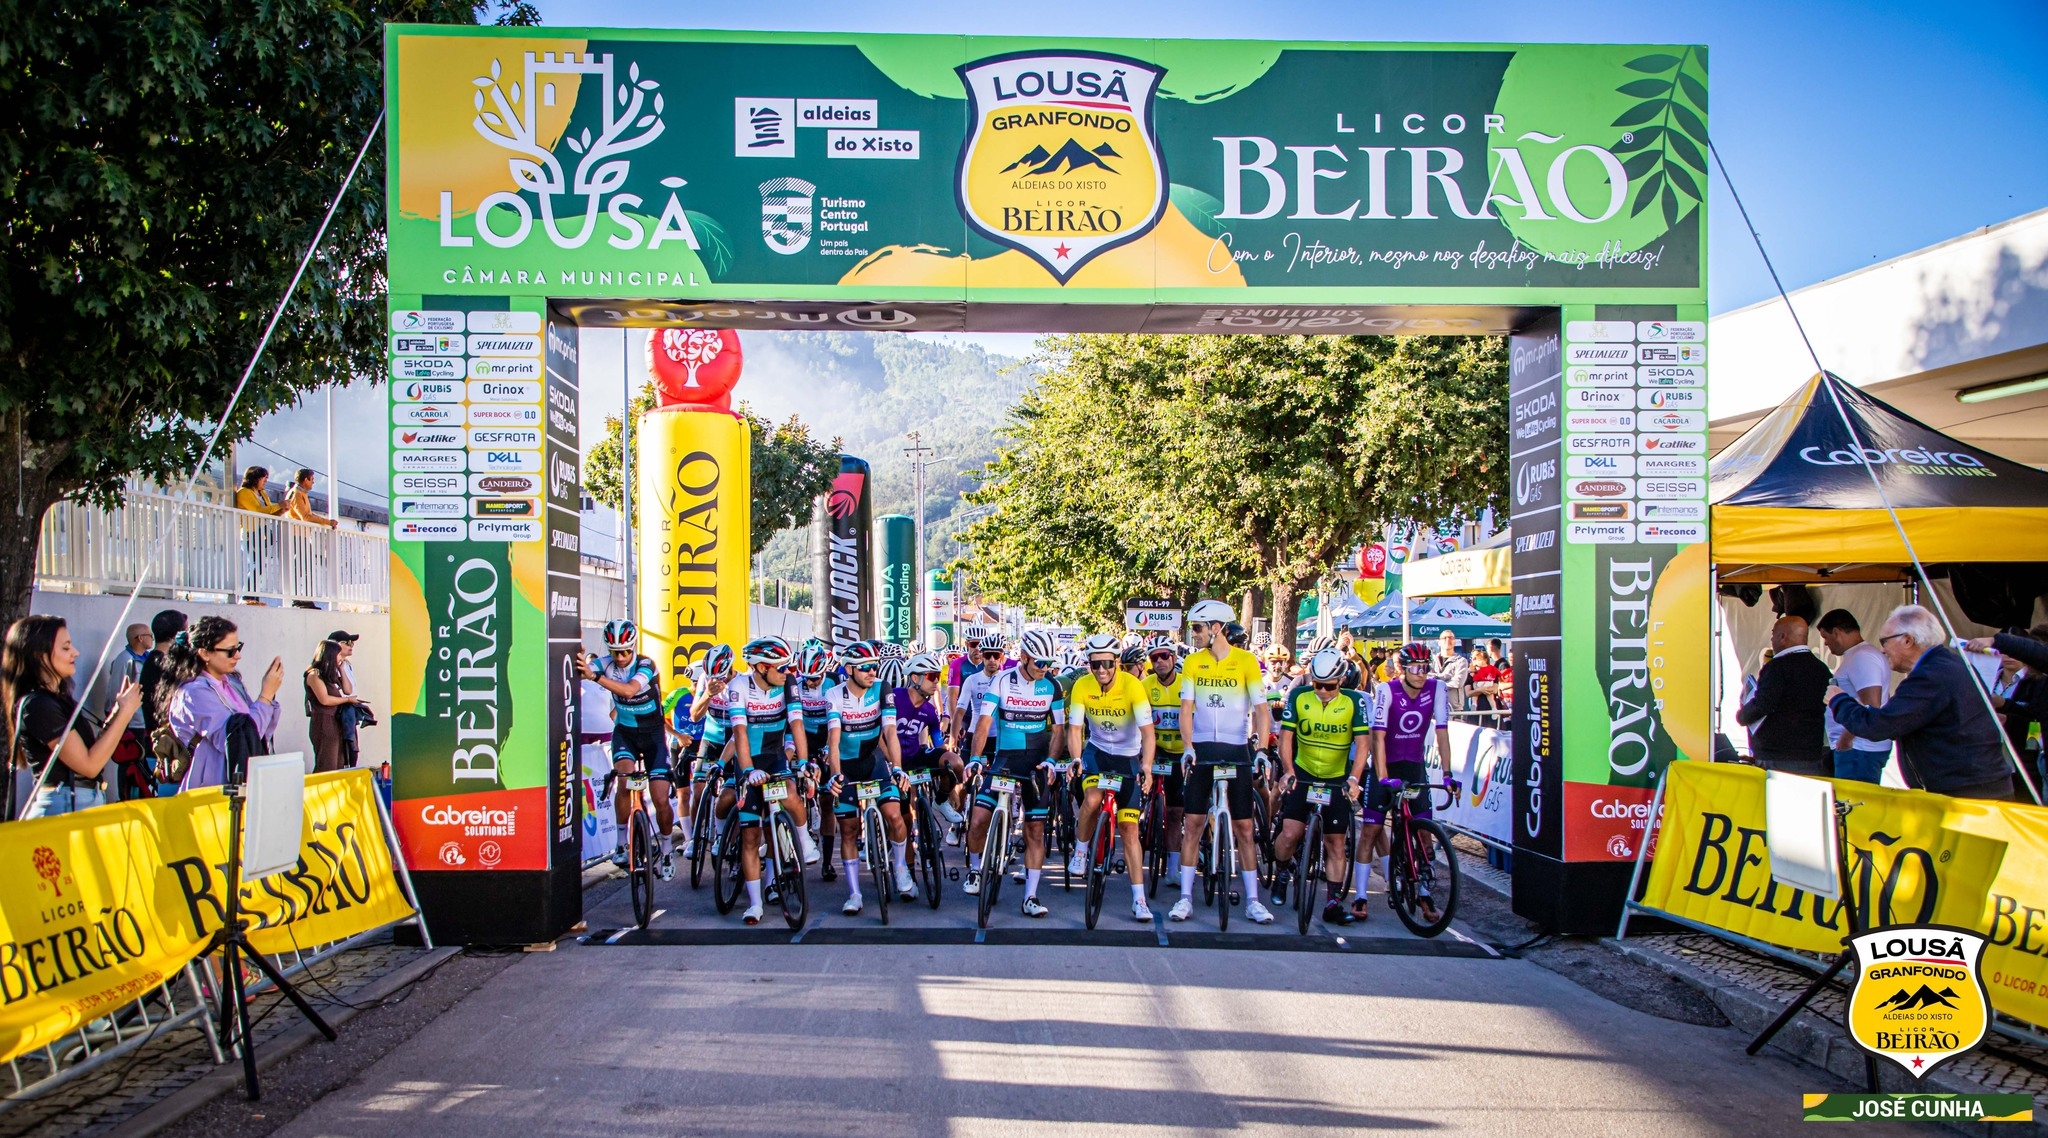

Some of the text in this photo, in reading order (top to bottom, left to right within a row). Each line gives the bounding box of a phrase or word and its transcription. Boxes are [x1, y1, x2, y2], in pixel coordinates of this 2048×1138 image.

[993, 69, 1130, 103] LOUSÃ
[803, 104, 872, 123] aldeias
[992, 111, 1132, 133] GRANFONDO
[1337, 112, 1506, 134] LICOR
[834, 136, 914, 153] do Xisto
[1011, 180, 1107, 190] ALDEIAS DO XISTO
[1213, 131, 1629, 224] BEIRÃO
[821, 197, 866, 208] Turismo
[821, 209, 858, 220] Centro
[1002, 206, 1123, 232] BEIRÃO
[820, 221, 869, 234] Portugal
[820, 248, 841, 256] dentro
[844, 248, 854, 256] do
[1206, 232, 1259, 274] Com
[1283, 232, 1363, 274] Interior,
[1369, 248, 1429, 271] mesmo
[1433, 248, 1460, 270] nos
[1469, 240, 1539, 270] desafios
[1544, 245, 1588, 270] mais
[443, 265, 701, 287] CÂMARA MUNICIPAL
[476, 341, 534, 350] SPECIALIZED
[1574, 350, 1629, 358] SPECIALIZED
[483, 383, 524, 394] Brinox
[1581, 391, 1620, 401] Brinox
[474, 433, 536, 442] GESFROTA
[1572, 439, 1630, 448] GESFROTA
[1660, 440, 1696, 448] catlike
[487, 452, 521, 463] DELL
[1585, 457, 1617, 467] DELL
[1799, 444, 1984, 468] Cabreira
[1895, 465, 1998, 477] SOLUTIONS
[403, 478, 457, 488] SEISSA
[1646, 483, 1696, 492] SEISSA
[1530, 483, 1542, 503] GÁS
[418, 525, 457, 533] reconco
[661, 519, 671, 613] LICOR
[899, 563, 911, 606] Cycling
[880, 563, 895, 642] KODA
[438, 624, 452, 718] LICOR
[447, 557, 498, 785] BEIRÃO
[1608, 557, 1654, 777] BEIRÃO
[1653, 621, 1665, 711] LICOR
[1196, 677, 1238, 688] BEIRÃO
[747, 701, 783, 712] Penacova
[1006, 695, 1047, 707] Penacova
[841, 709, 878, 720] Penacova
[1088, 706, 1126, 718] BEIRÃO
[1539, 673, 1550, 757] SOLUTIONS
[563, 653, 576, 827] Cabreira
[1526, 672, 1542, 838] Cabreira
[559, 741, 567, 827] SOLUTIONS
[1484, 786, 1503, 812] GÁS
[421, 804, 508, 825] Cabreira
[464, 826, 508, 836] SOLUTIONS
[41, 901, 86, 924] LICOR
[0, 906, 146, 1005] BEIRÃO
[1993, 971, 2037, 994] O LICOR
[104, 988, 119, 1000] DE
